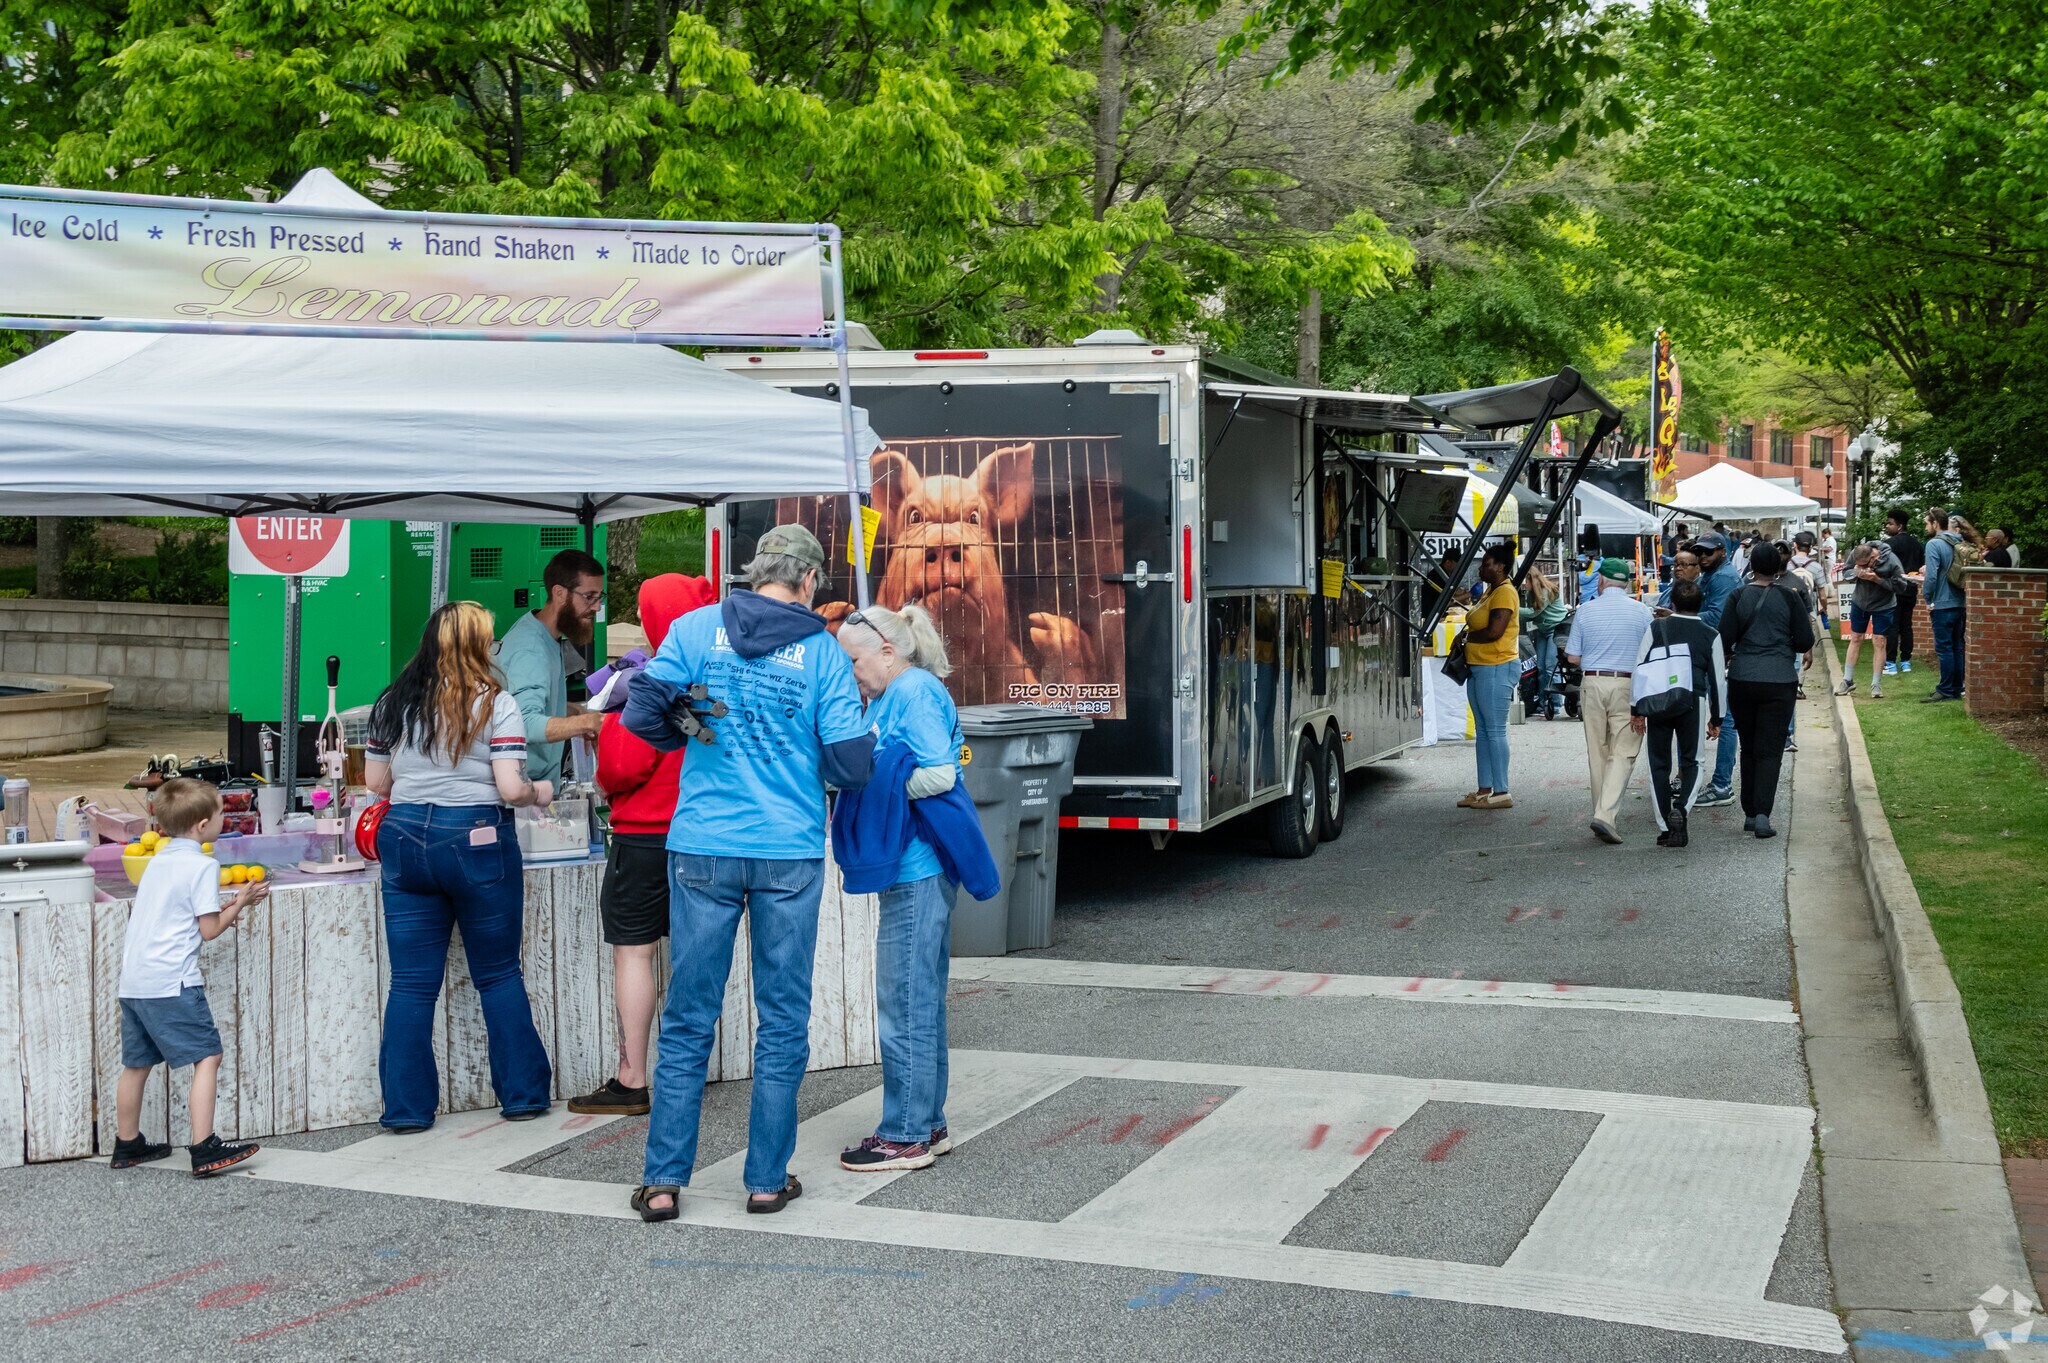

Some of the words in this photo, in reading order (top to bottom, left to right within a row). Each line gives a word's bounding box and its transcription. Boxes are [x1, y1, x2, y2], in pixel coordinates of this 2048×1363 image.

[12, 212, 46, 238] Ice
[62, 215, 119, 242] Cold
[187, 221, 256, 248] Fresh
[270, 225, 365, 253] Pressed
[424, 231, 481, 257] Hand
[494, 235, 575, 261] Shaken
[632, 241, 690, 264] Made
[702, 245, 720, 265] to
[731, 244, 787, 266] Order
[174, 254, 662, 329] Lemonade
[257, 516, 323, 540] ENTER
[405, 520, 435, 532] SUNBE
[730, 665, 744, 675] SHI
[1009, 684, 1041, 698] PIG
[1045, 684, 1074, 698] ON
[1076, 684, 1120, 698] FIRE
[1022, 779, 1042, 787] PROPERTY
[1042, 777, 1048, 785] OF
[1027, 788, 1037, 796] CITY
[1037, 788, 1043, 796] OF
